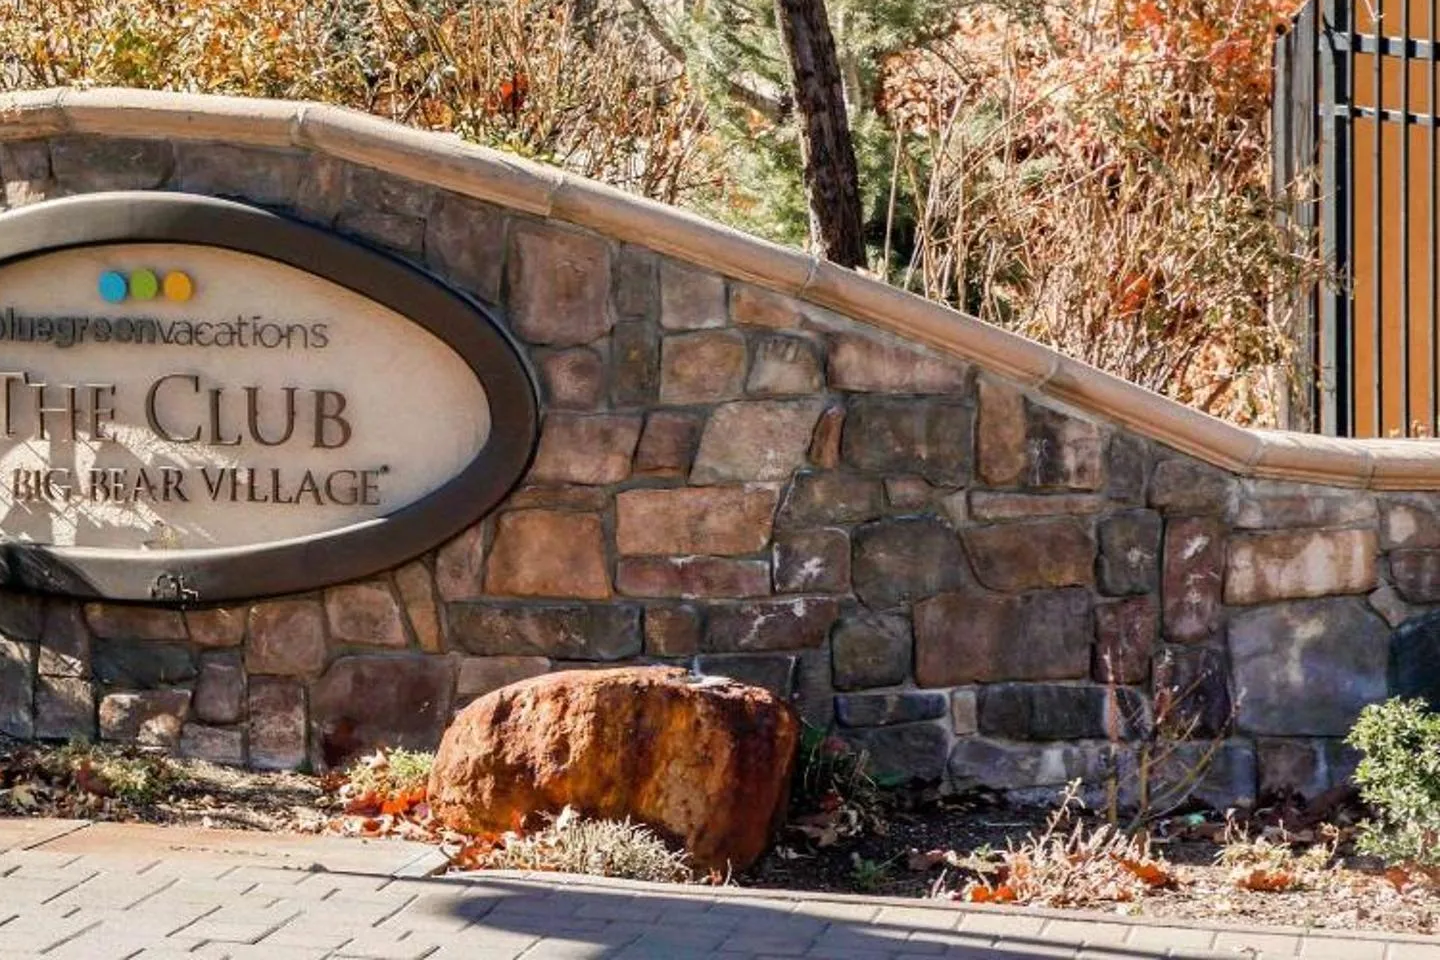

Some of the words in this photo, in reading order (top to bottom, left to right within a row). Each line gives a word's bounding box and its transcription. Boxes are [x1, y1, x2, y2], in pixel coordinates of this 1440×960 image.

[145, 373, 353, 450] CLUB
[12, 465, 71, 502] BIG
[88, 466, 190, 504] BEAR
